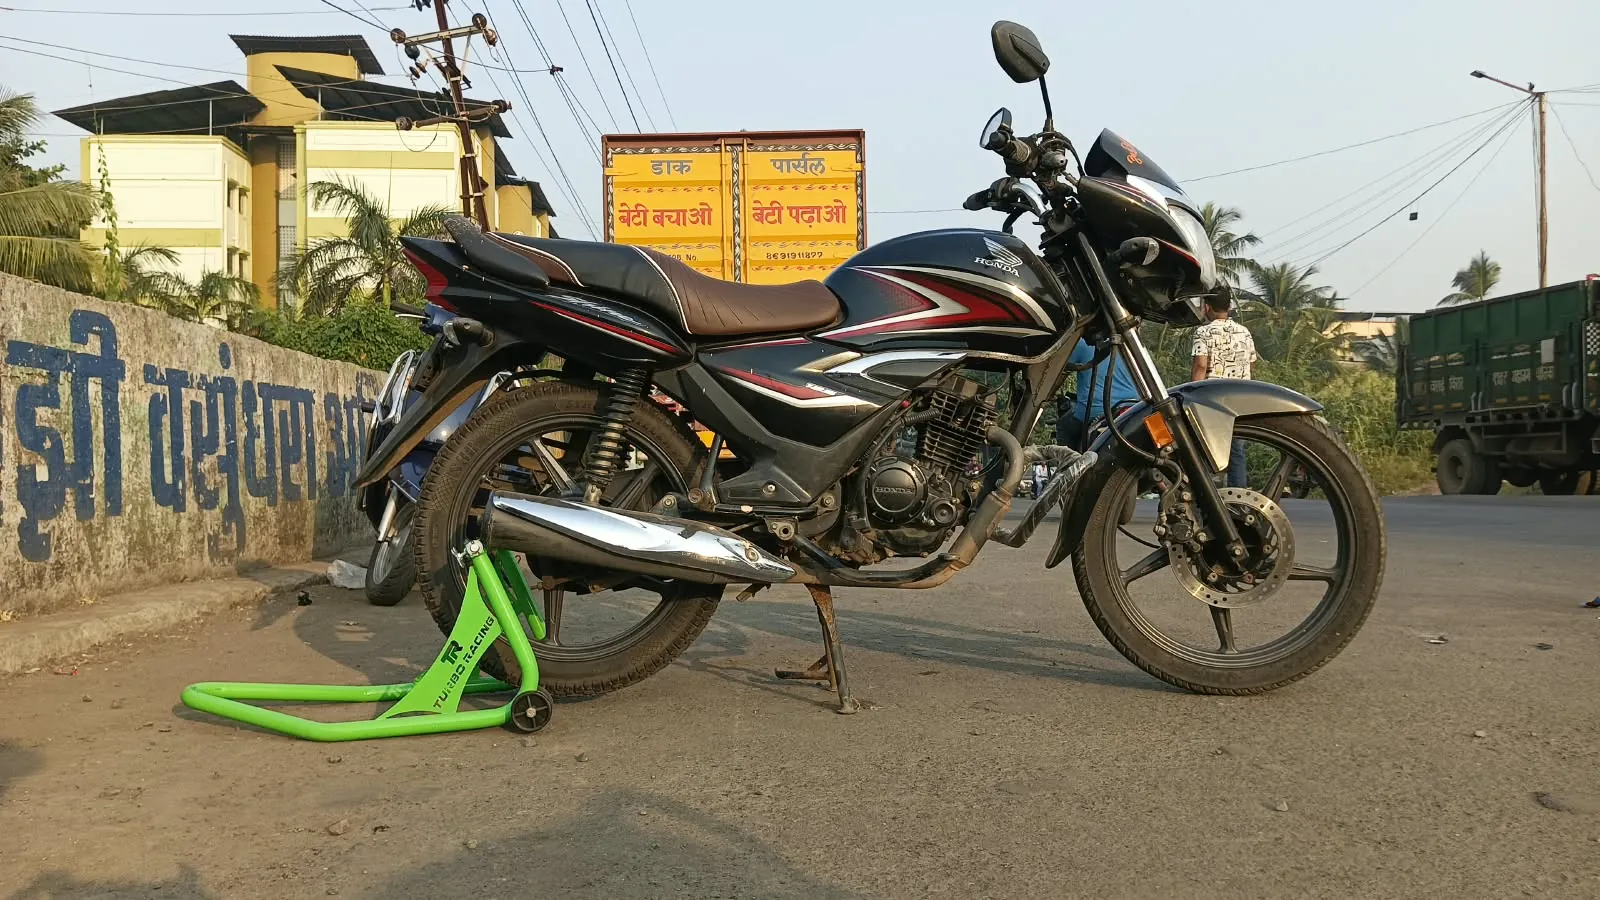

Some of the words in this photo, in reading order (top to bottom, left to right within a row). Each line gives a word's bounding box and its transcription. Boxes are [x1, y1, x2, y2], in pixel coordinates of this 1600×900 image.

[650, 159, 693, 176] डाक
[769, 152, 826, 176] पार्सल
[618, 202, 649, 227] बेटी
[652, 202, 713, 228] बचाओ
[752, 199, 784, 225] बेटी
[787, 198, 847, 228] पढ़ाओ
[766, 251, 823, 260] 8691911877
[973, 256, 1020, 278] HONDA
[875, 486, 915, 494] HONDA
[433, 663, 466, 709] TURBO
[463, 615, 494, 663] RACING
[441, 640, 463, 665] TR
